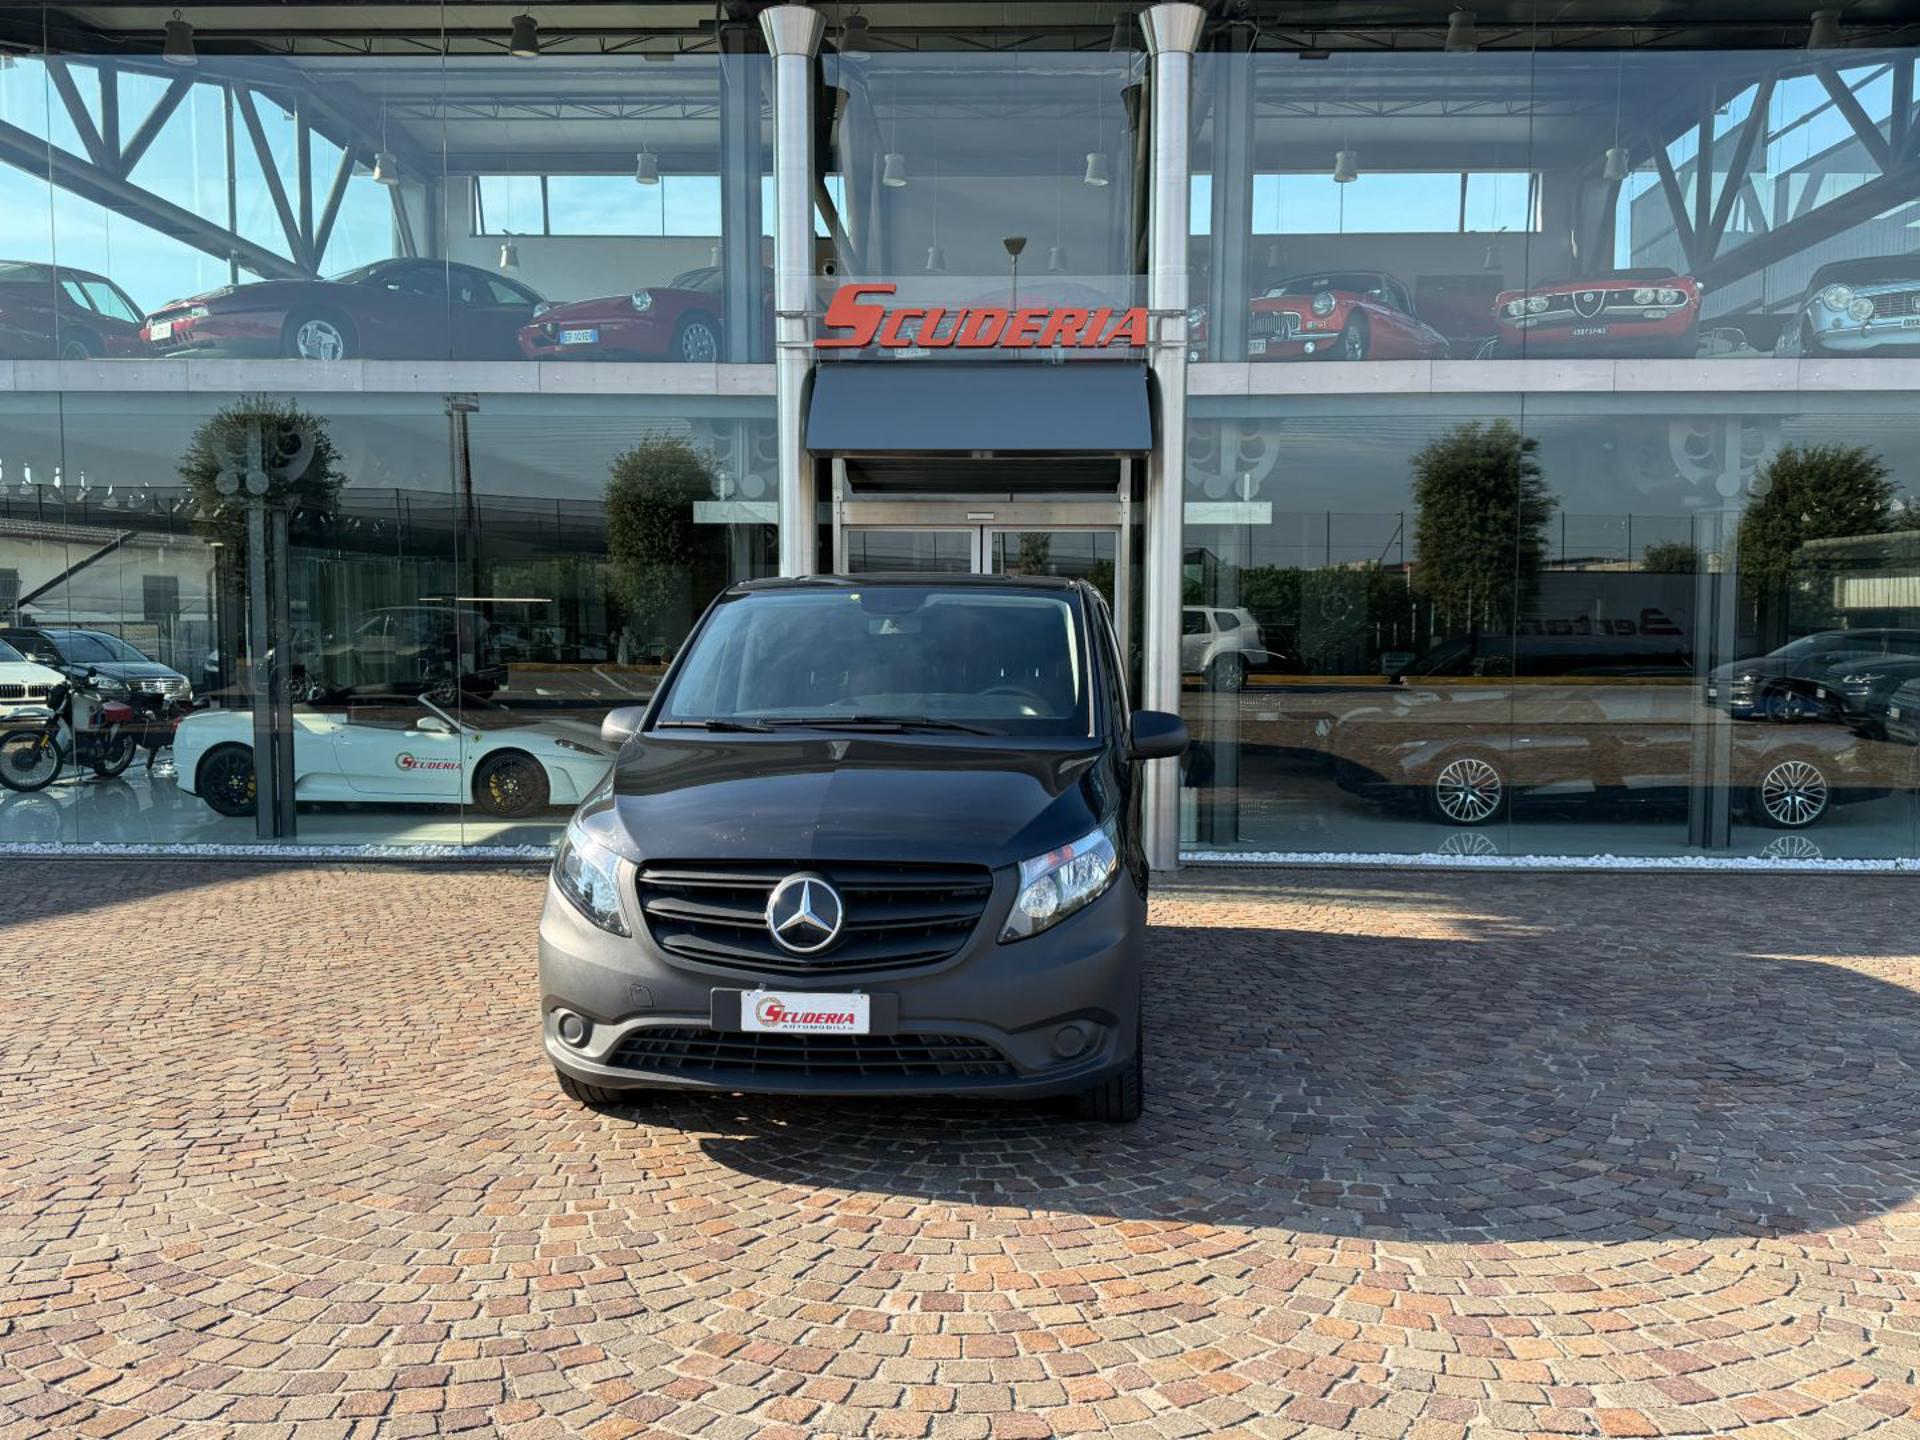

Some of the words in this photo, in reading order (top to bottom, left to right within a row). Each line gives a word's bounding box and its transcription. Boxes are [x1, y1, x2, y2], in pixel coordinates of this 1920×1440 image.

[814, 283, 1148, 348] SCUDERIA
[402, 757, 462, 769] SCUDERIA
[763, 1004, 855, 1025] SCUDERIA
